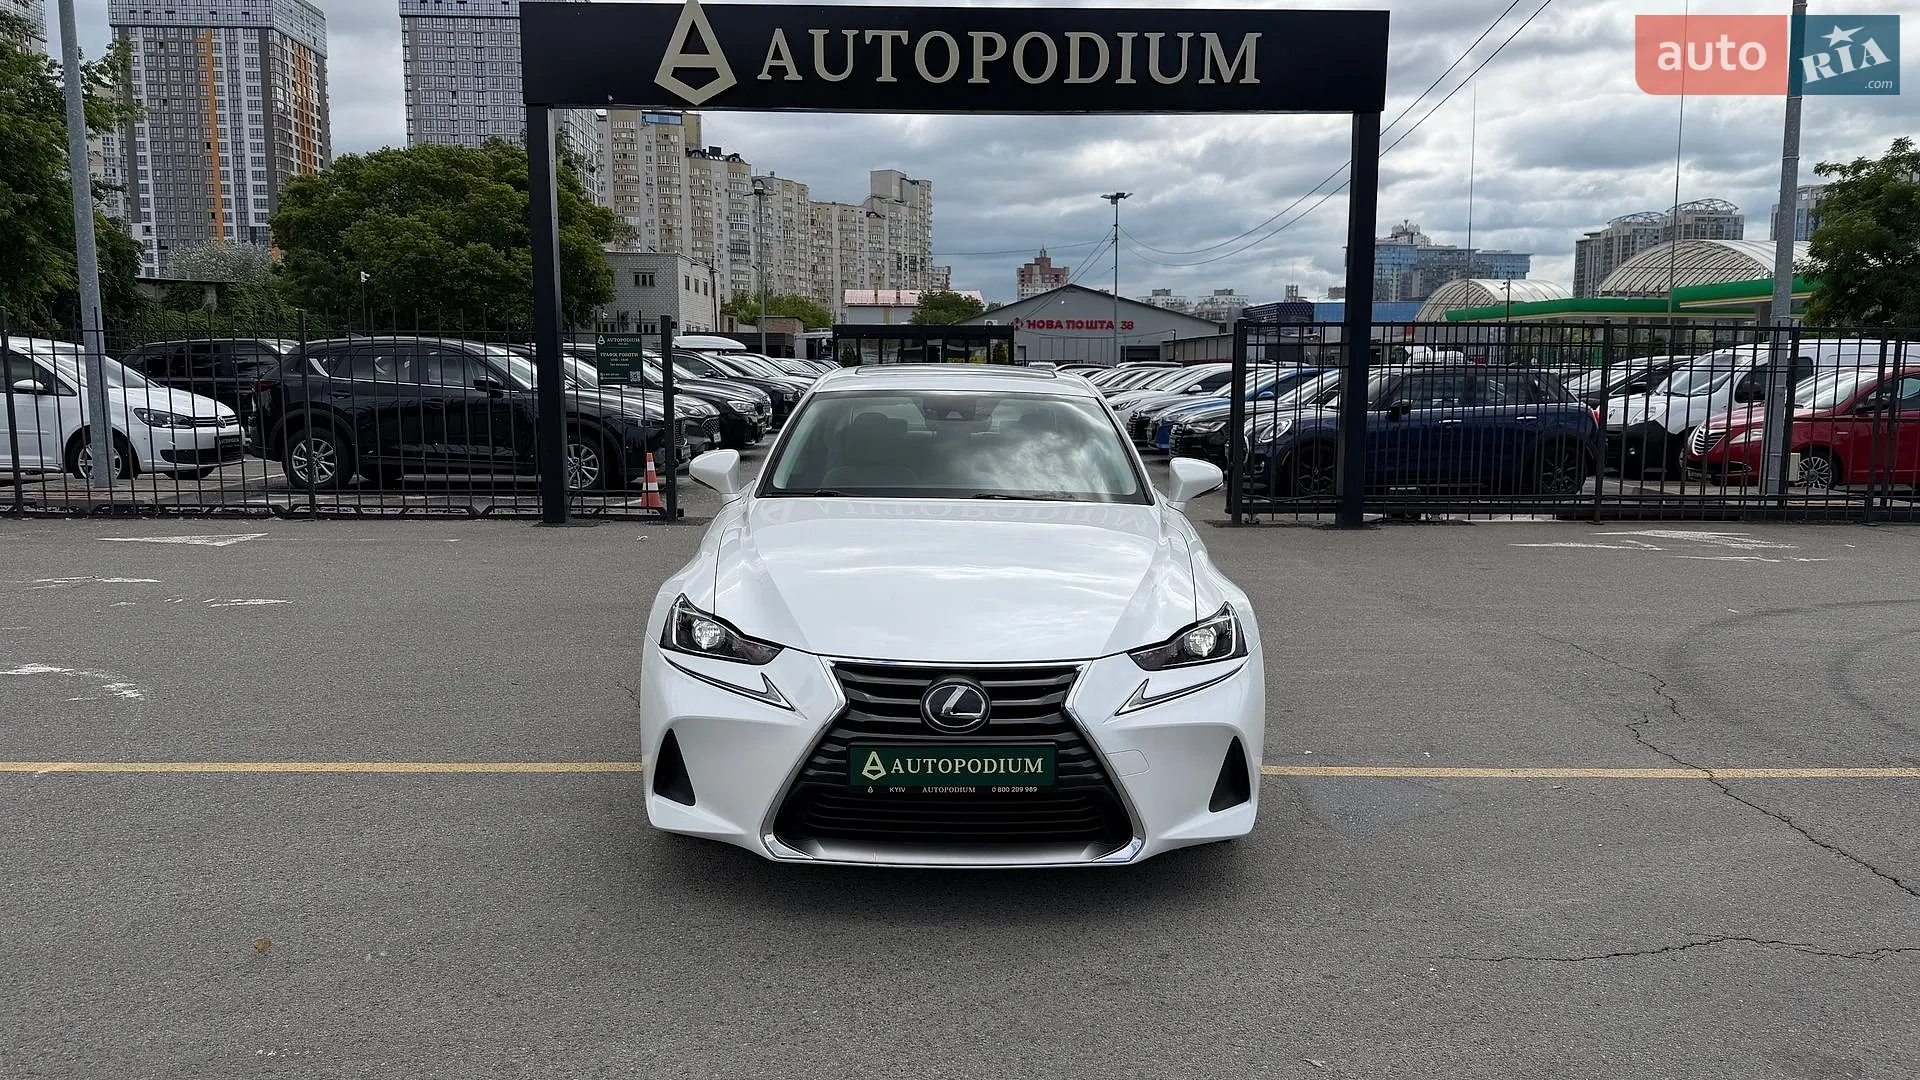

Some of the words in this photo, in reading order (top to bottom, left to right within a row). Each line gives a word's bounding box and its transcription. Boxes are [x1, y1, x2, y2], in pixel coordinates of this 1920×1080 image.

[757, 28, 1263, 85] AUTOPODIUM
[1027, 320, 1063, 330] НОВА
[1065, 320, 1114, 330] ПОШТА
[1120, 320, 1134, 331] 38
[890, 757, 1044, 774] AUTOPODIUM
